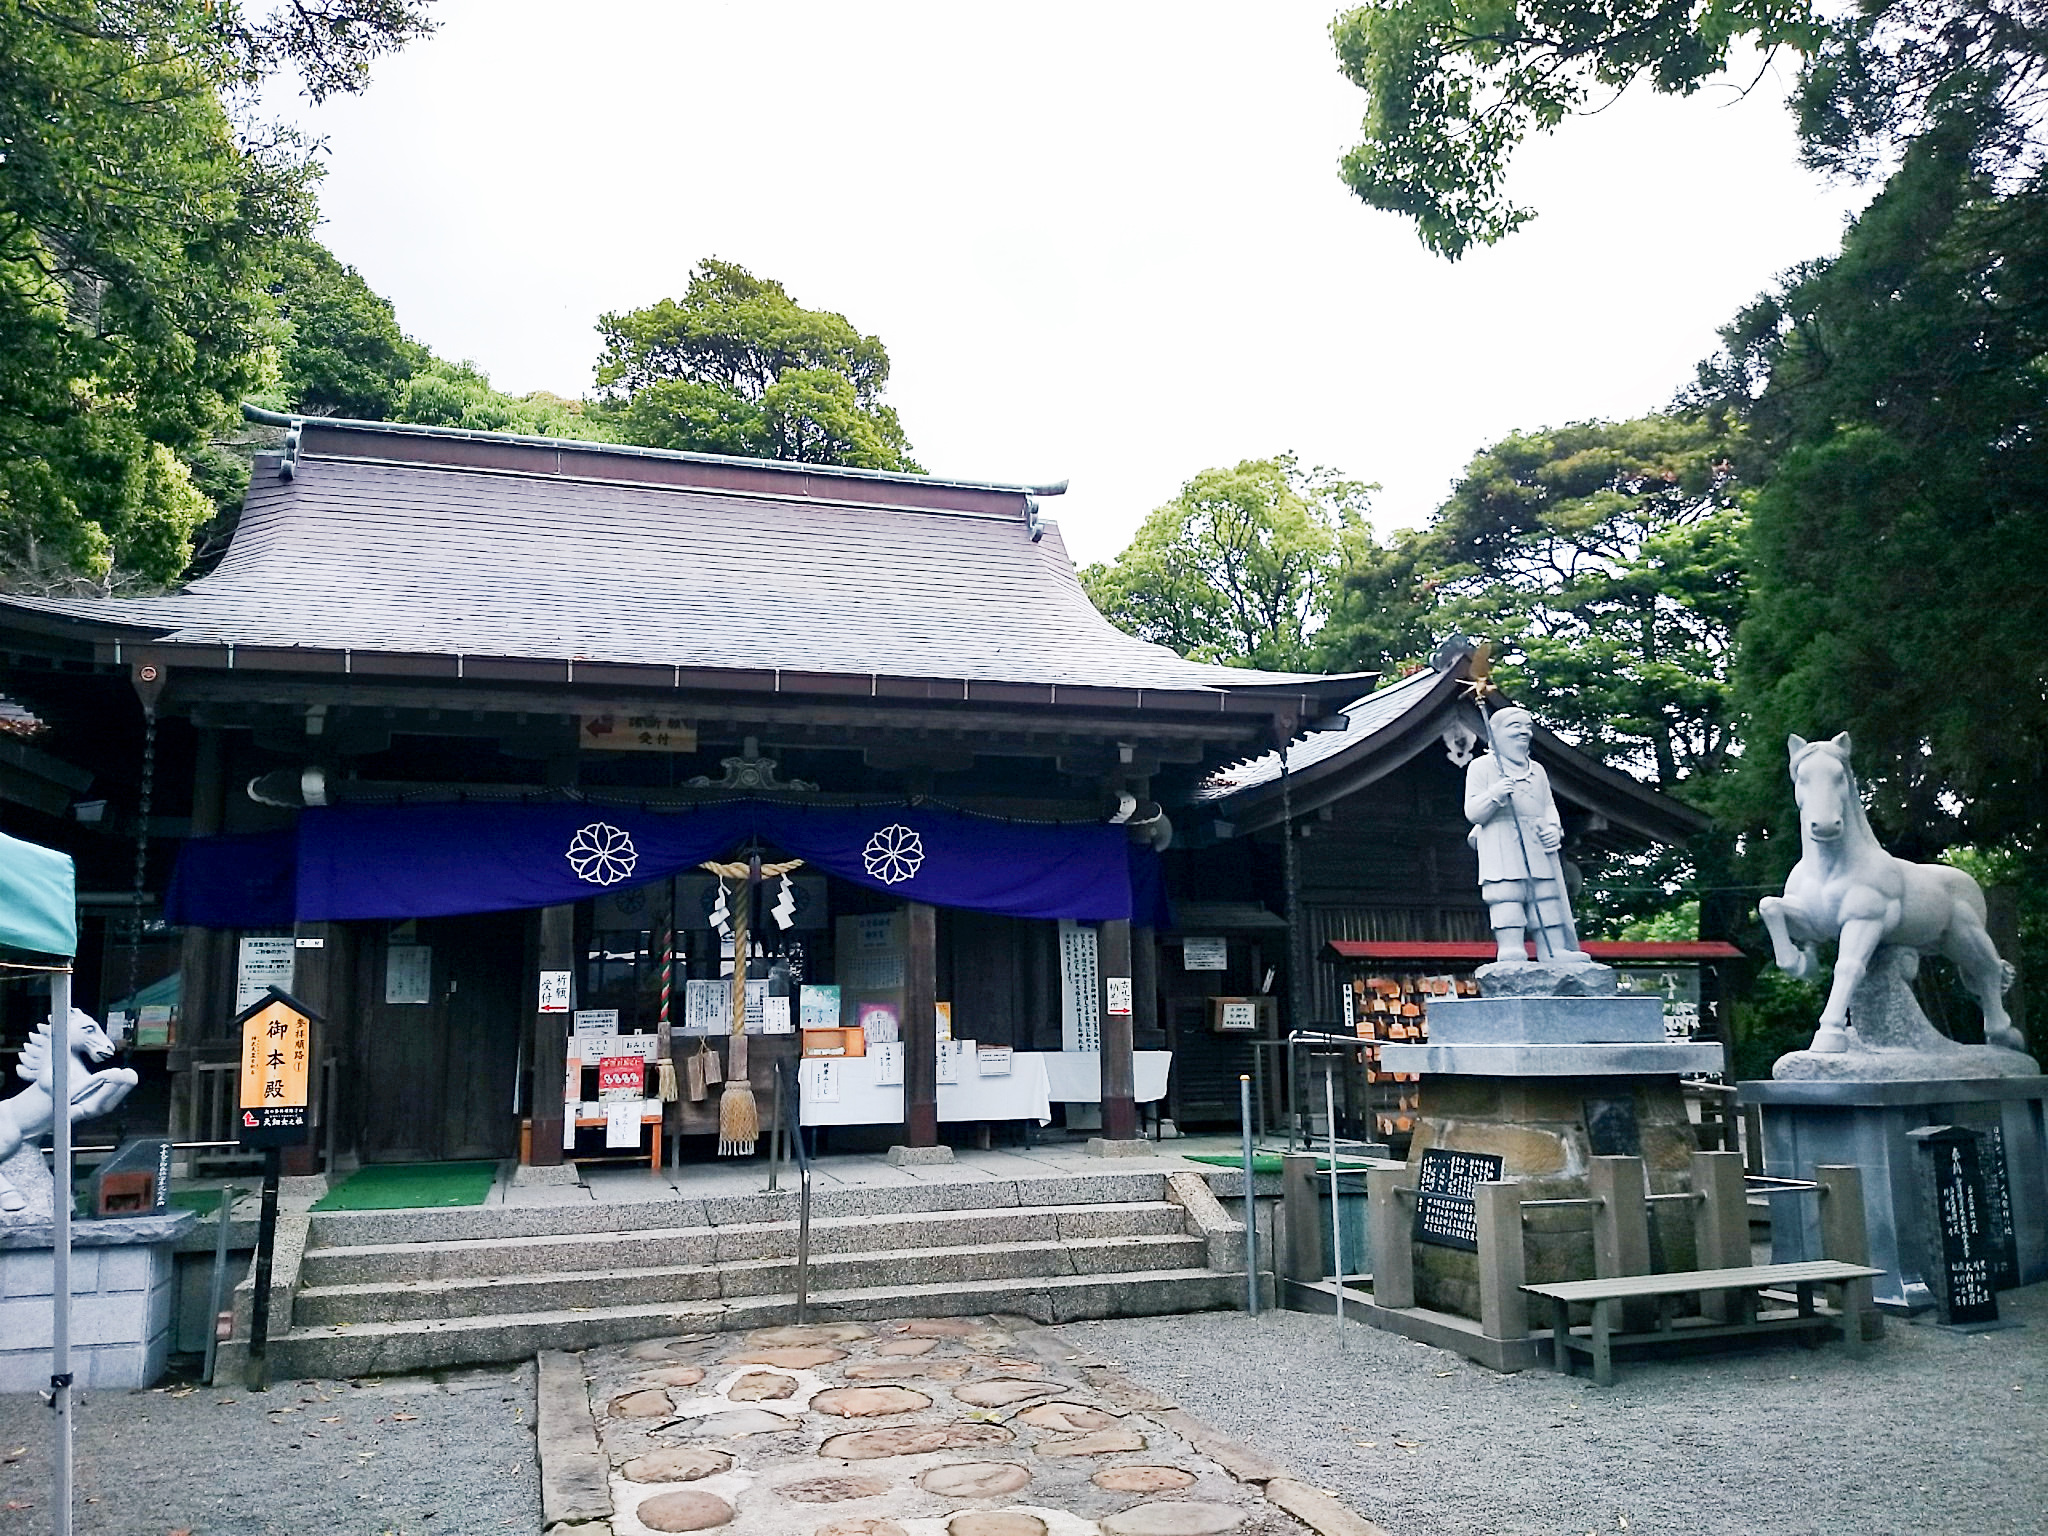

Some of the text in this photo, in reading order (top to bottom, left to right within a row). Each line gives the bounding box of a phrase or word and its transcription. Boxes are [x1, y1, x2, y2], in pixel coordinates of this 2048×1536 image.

[638, 731, 670, 745] 受付
[541, 979, 553, 1003] 受付
[556, 975, 568, 998] 祈願
[626, 1041, 654, 1049] おみくじ
[264, 1019, 289, 1099] 御本殿
